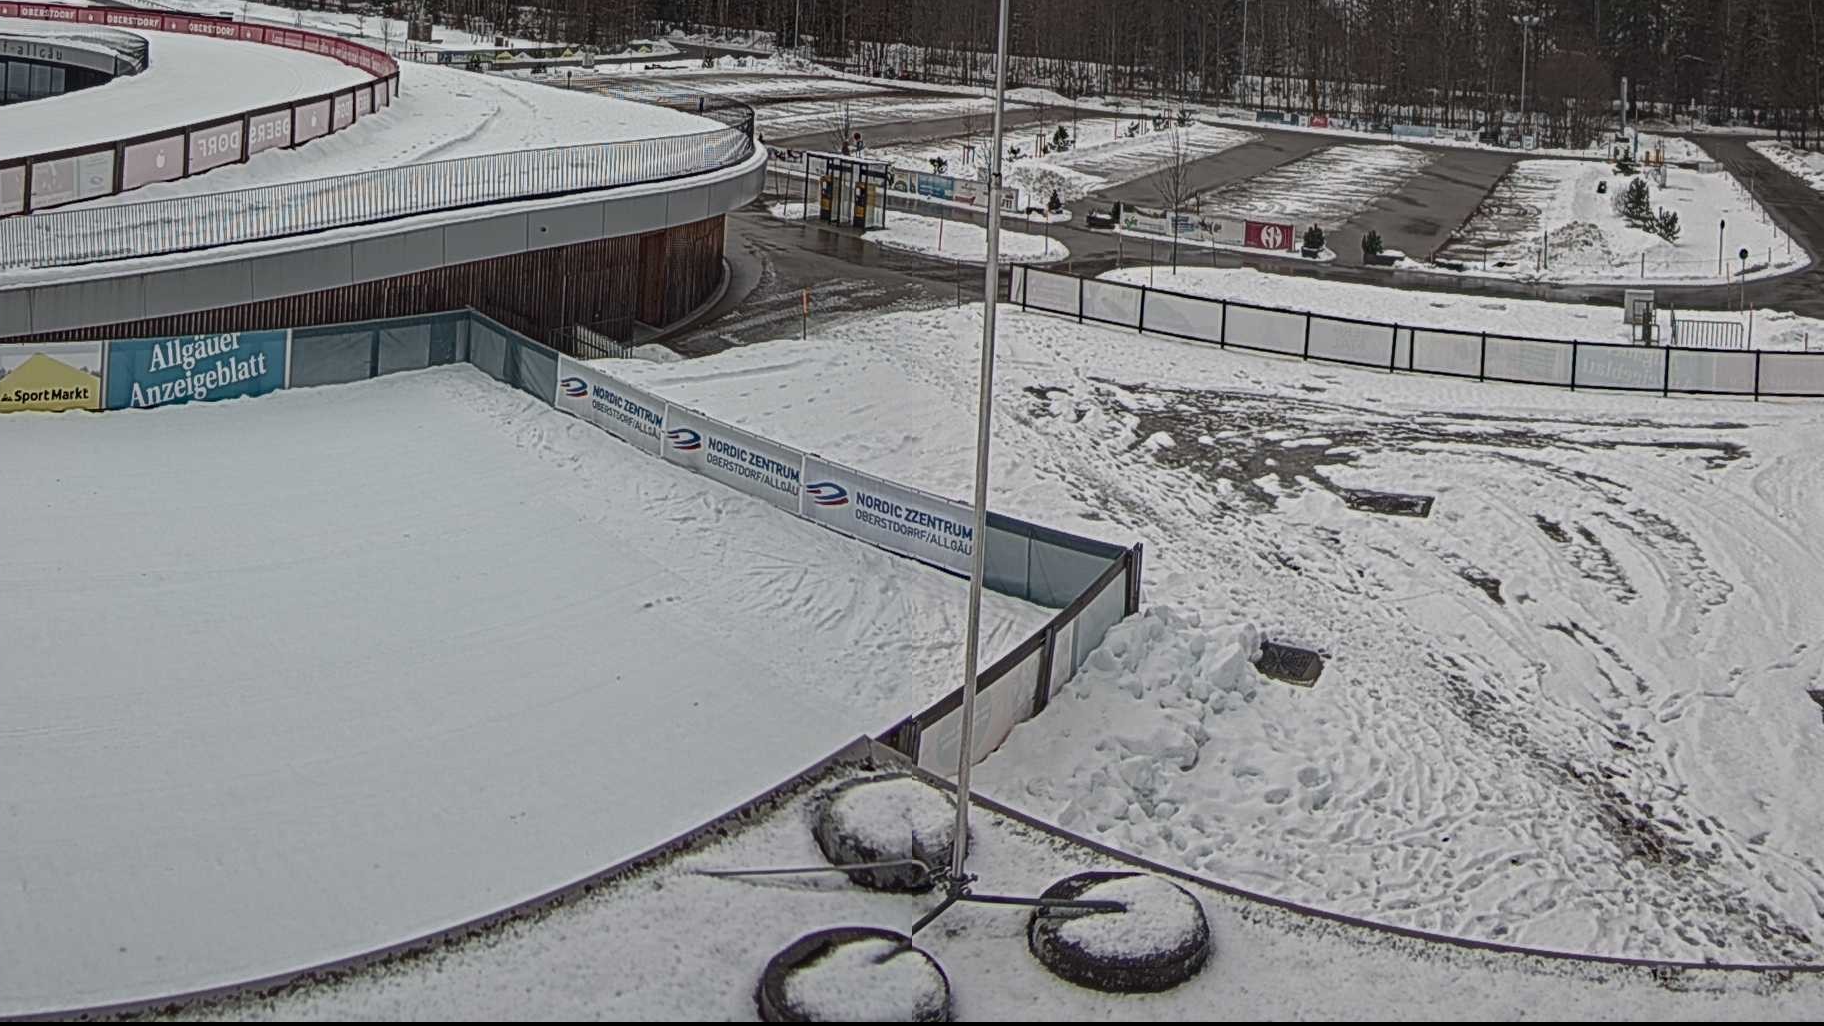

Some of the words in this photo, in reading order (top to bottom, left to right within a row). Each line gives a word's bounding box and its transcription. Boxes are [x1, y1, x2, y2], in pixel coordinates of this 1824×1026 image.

[149, 333, 241, 373] Allgäuer
[130, 352, 267, 408] Anzeigeblatt
[592, 385, 623, 407] NORDIC
[623, 399, 664, 427] ZENTRUM
[708, 437, 747, 462] NORDIC
[749, 454, 801, 481] ZENTRUM
[856, 492, 903, 518] NORDIC
